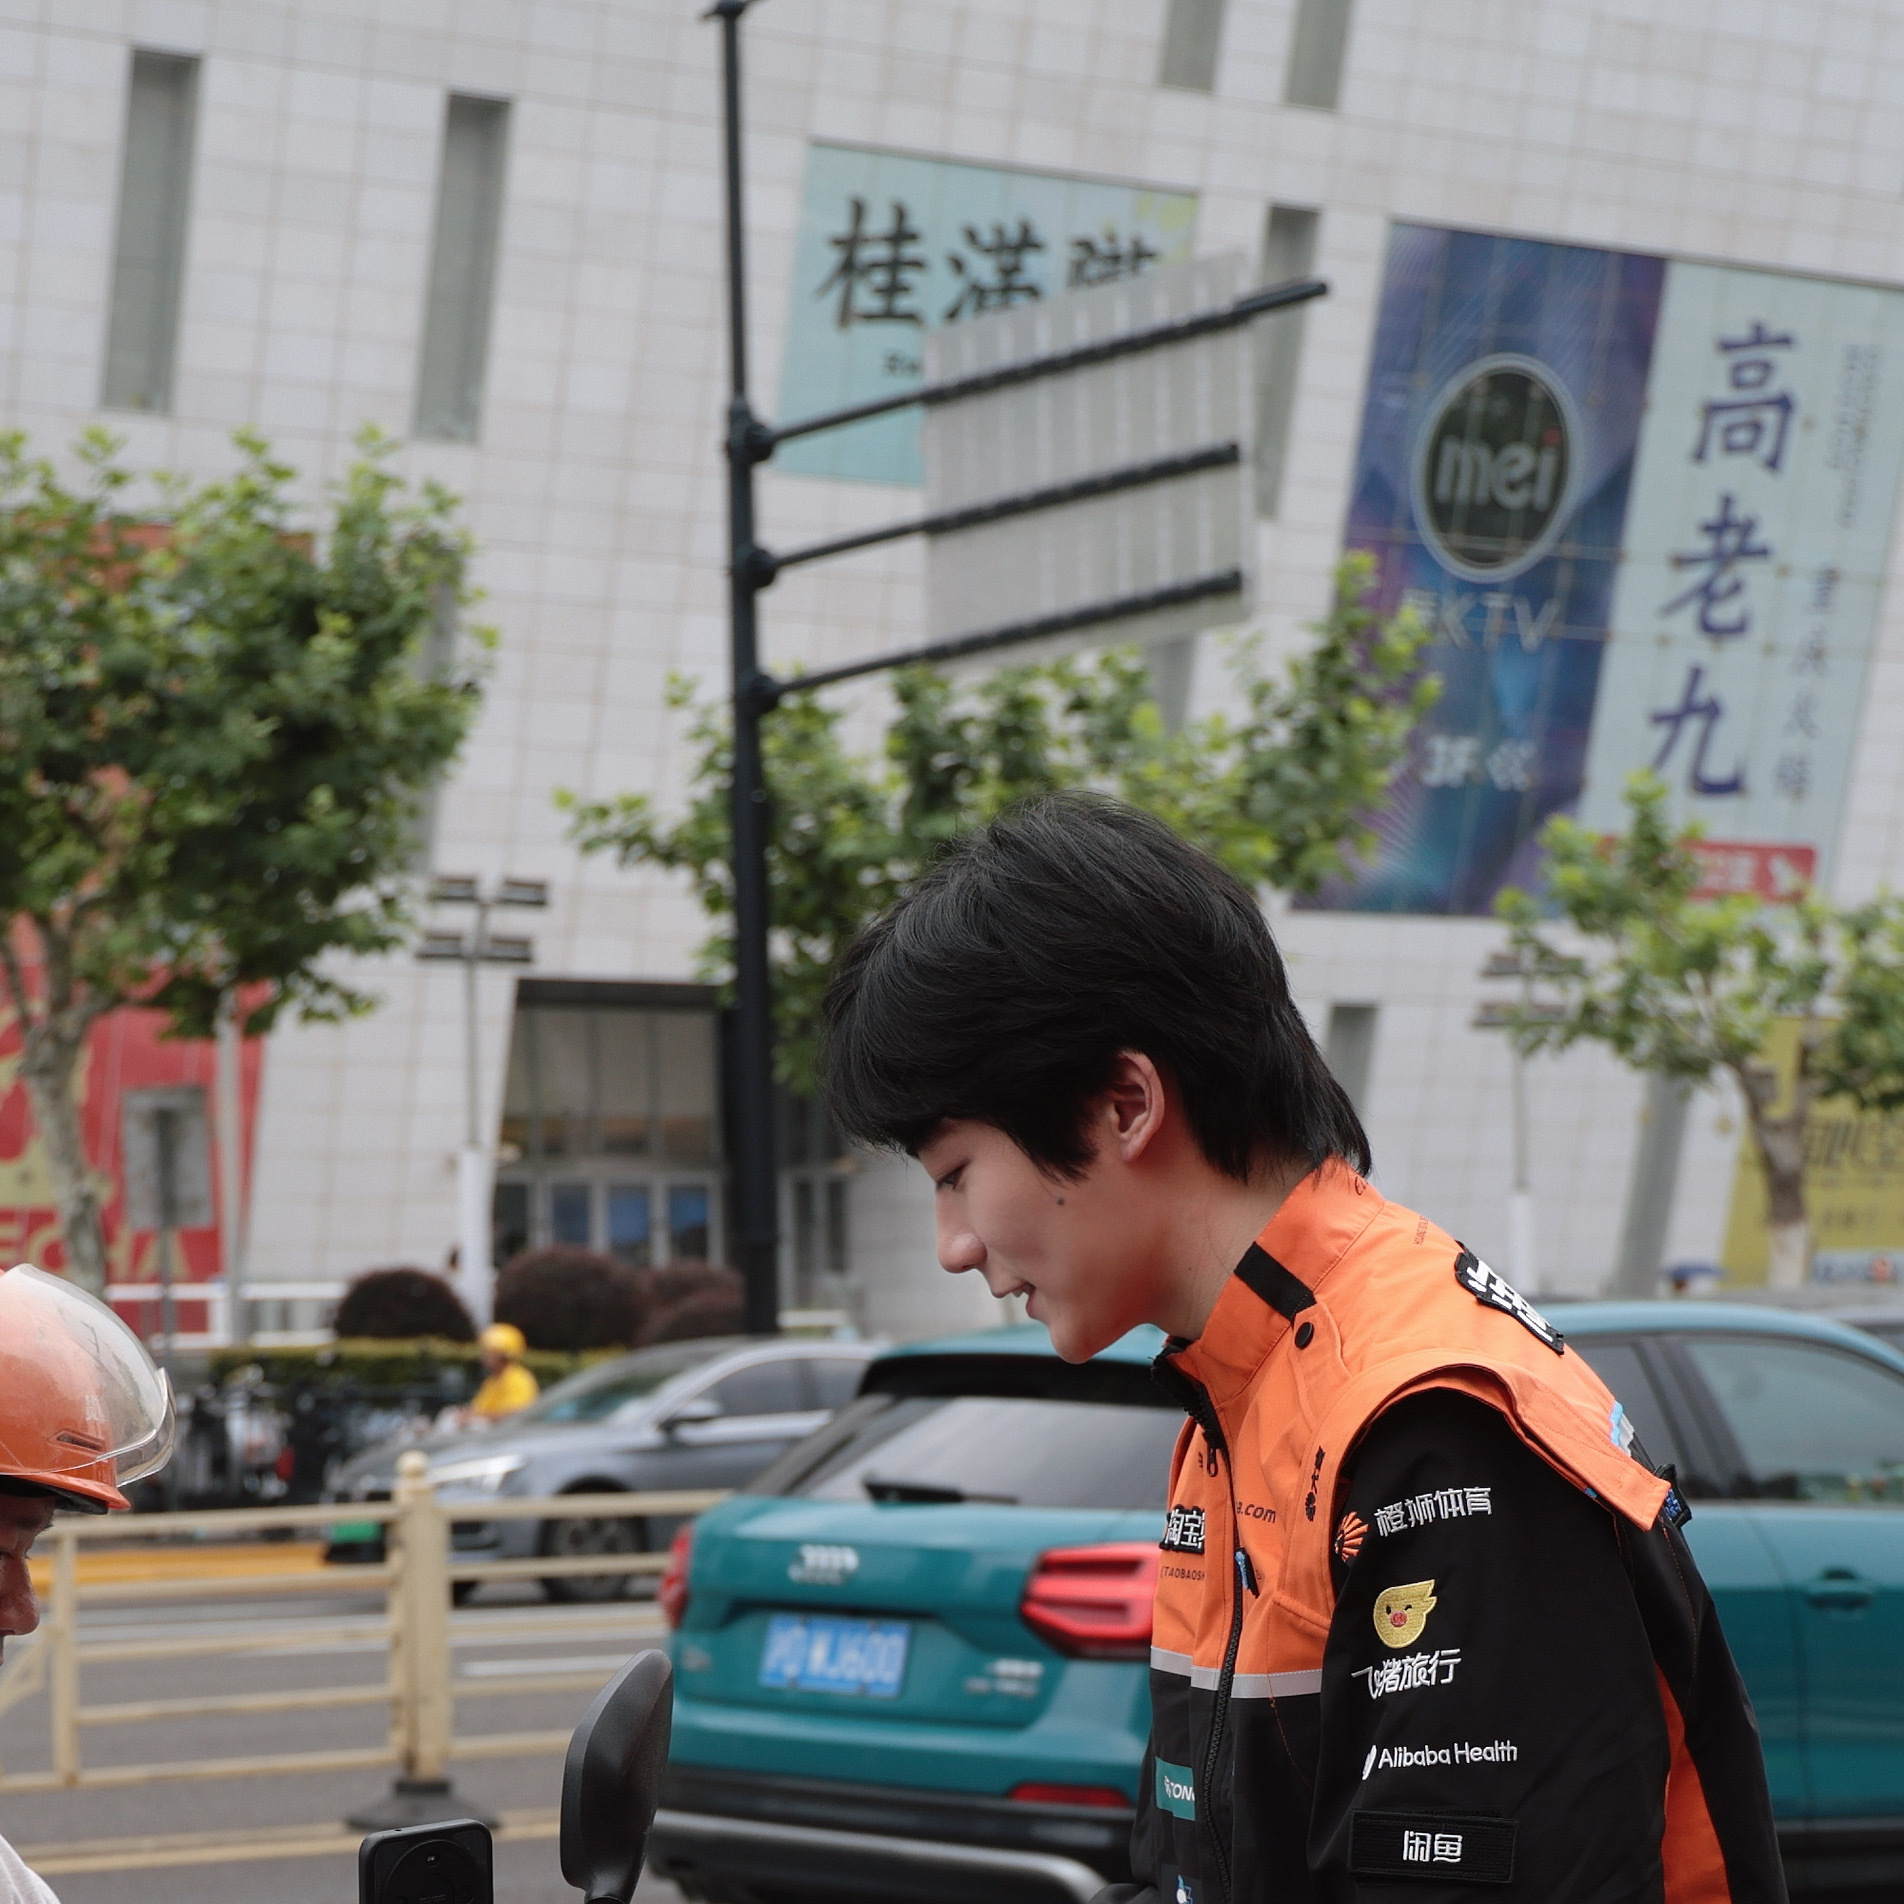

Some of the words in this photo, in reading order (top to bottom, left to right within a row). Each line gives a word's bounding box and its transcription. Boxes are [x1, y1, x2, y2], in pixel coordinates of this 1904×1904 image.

[1435, 426, 1562, 511] mei
[1651, 318, 1795, 798] 高老九
[1373, 1486, 1493, 1538] 橙狮体育
[1351, 1648, 1462, 1700] 飞猪旅行
[1378, 1742, 1451, 1771] Alibaba
[1455, 1739, 1518, 1765] Health
[1402, 1830, 1463, 1863] 闲鱼
